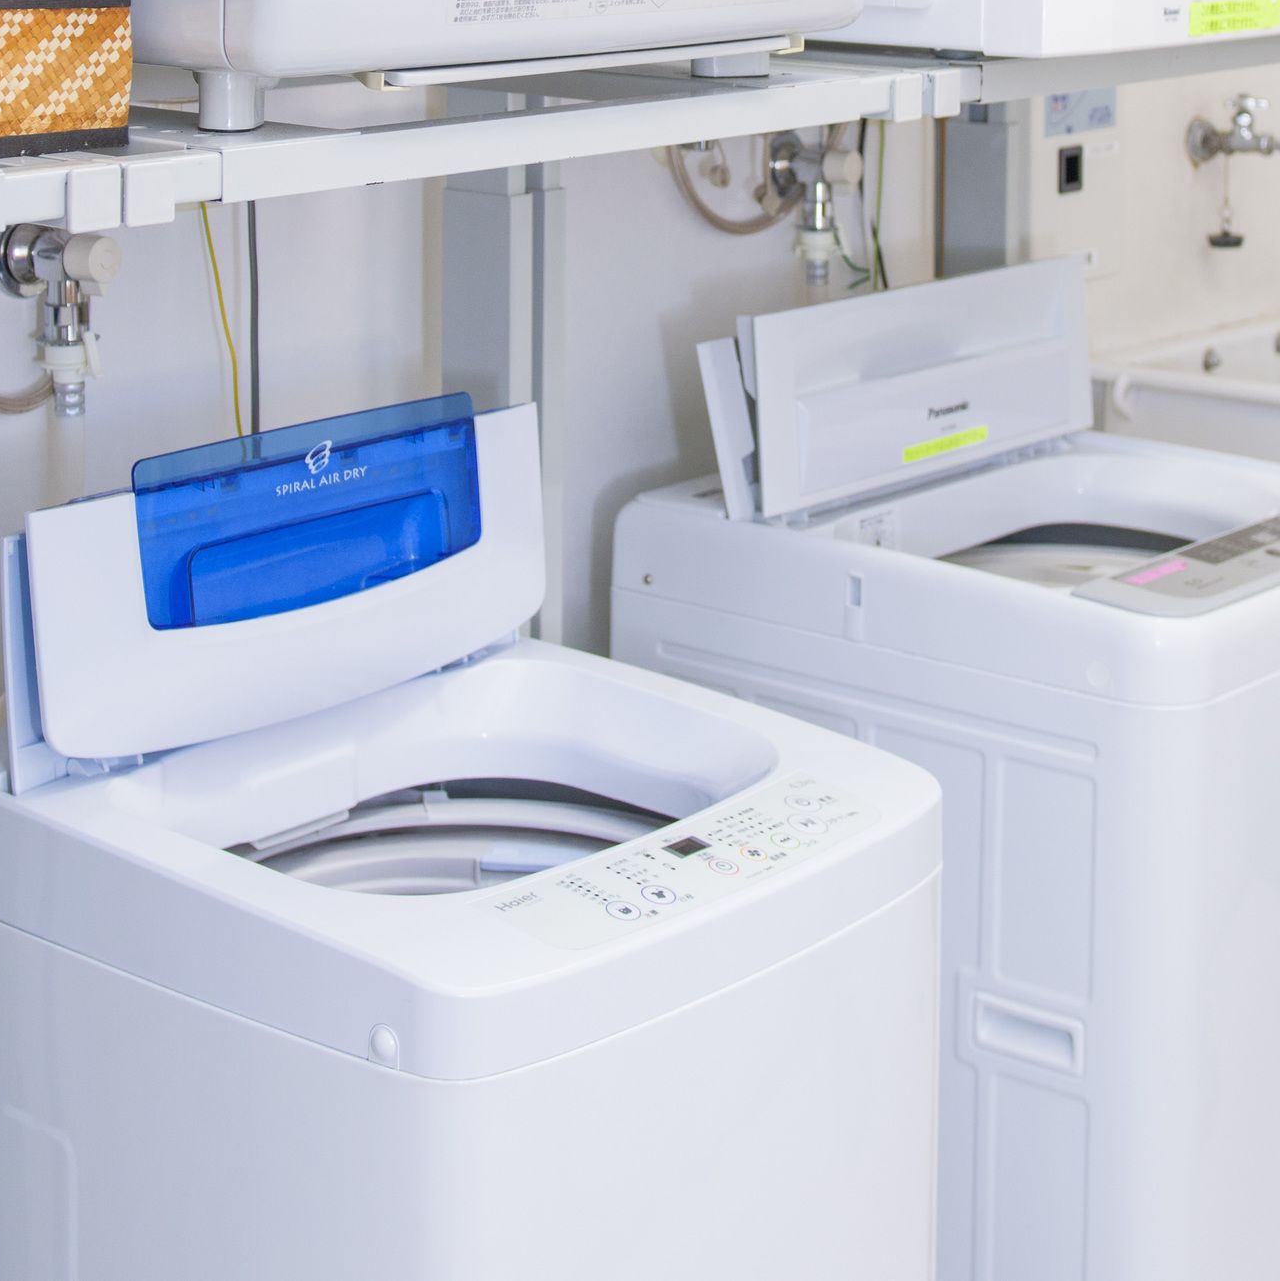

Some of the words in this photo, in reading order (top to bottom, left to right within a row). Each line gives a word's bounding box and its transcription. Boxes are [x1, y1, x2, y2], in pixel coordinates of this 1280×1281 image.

[275, 478, 316, 497] SPIRAL
[319, 472, 340, 486] AIR
[343, 466, 368, 481] DRY
[494, 891, 539, 913] Haier
